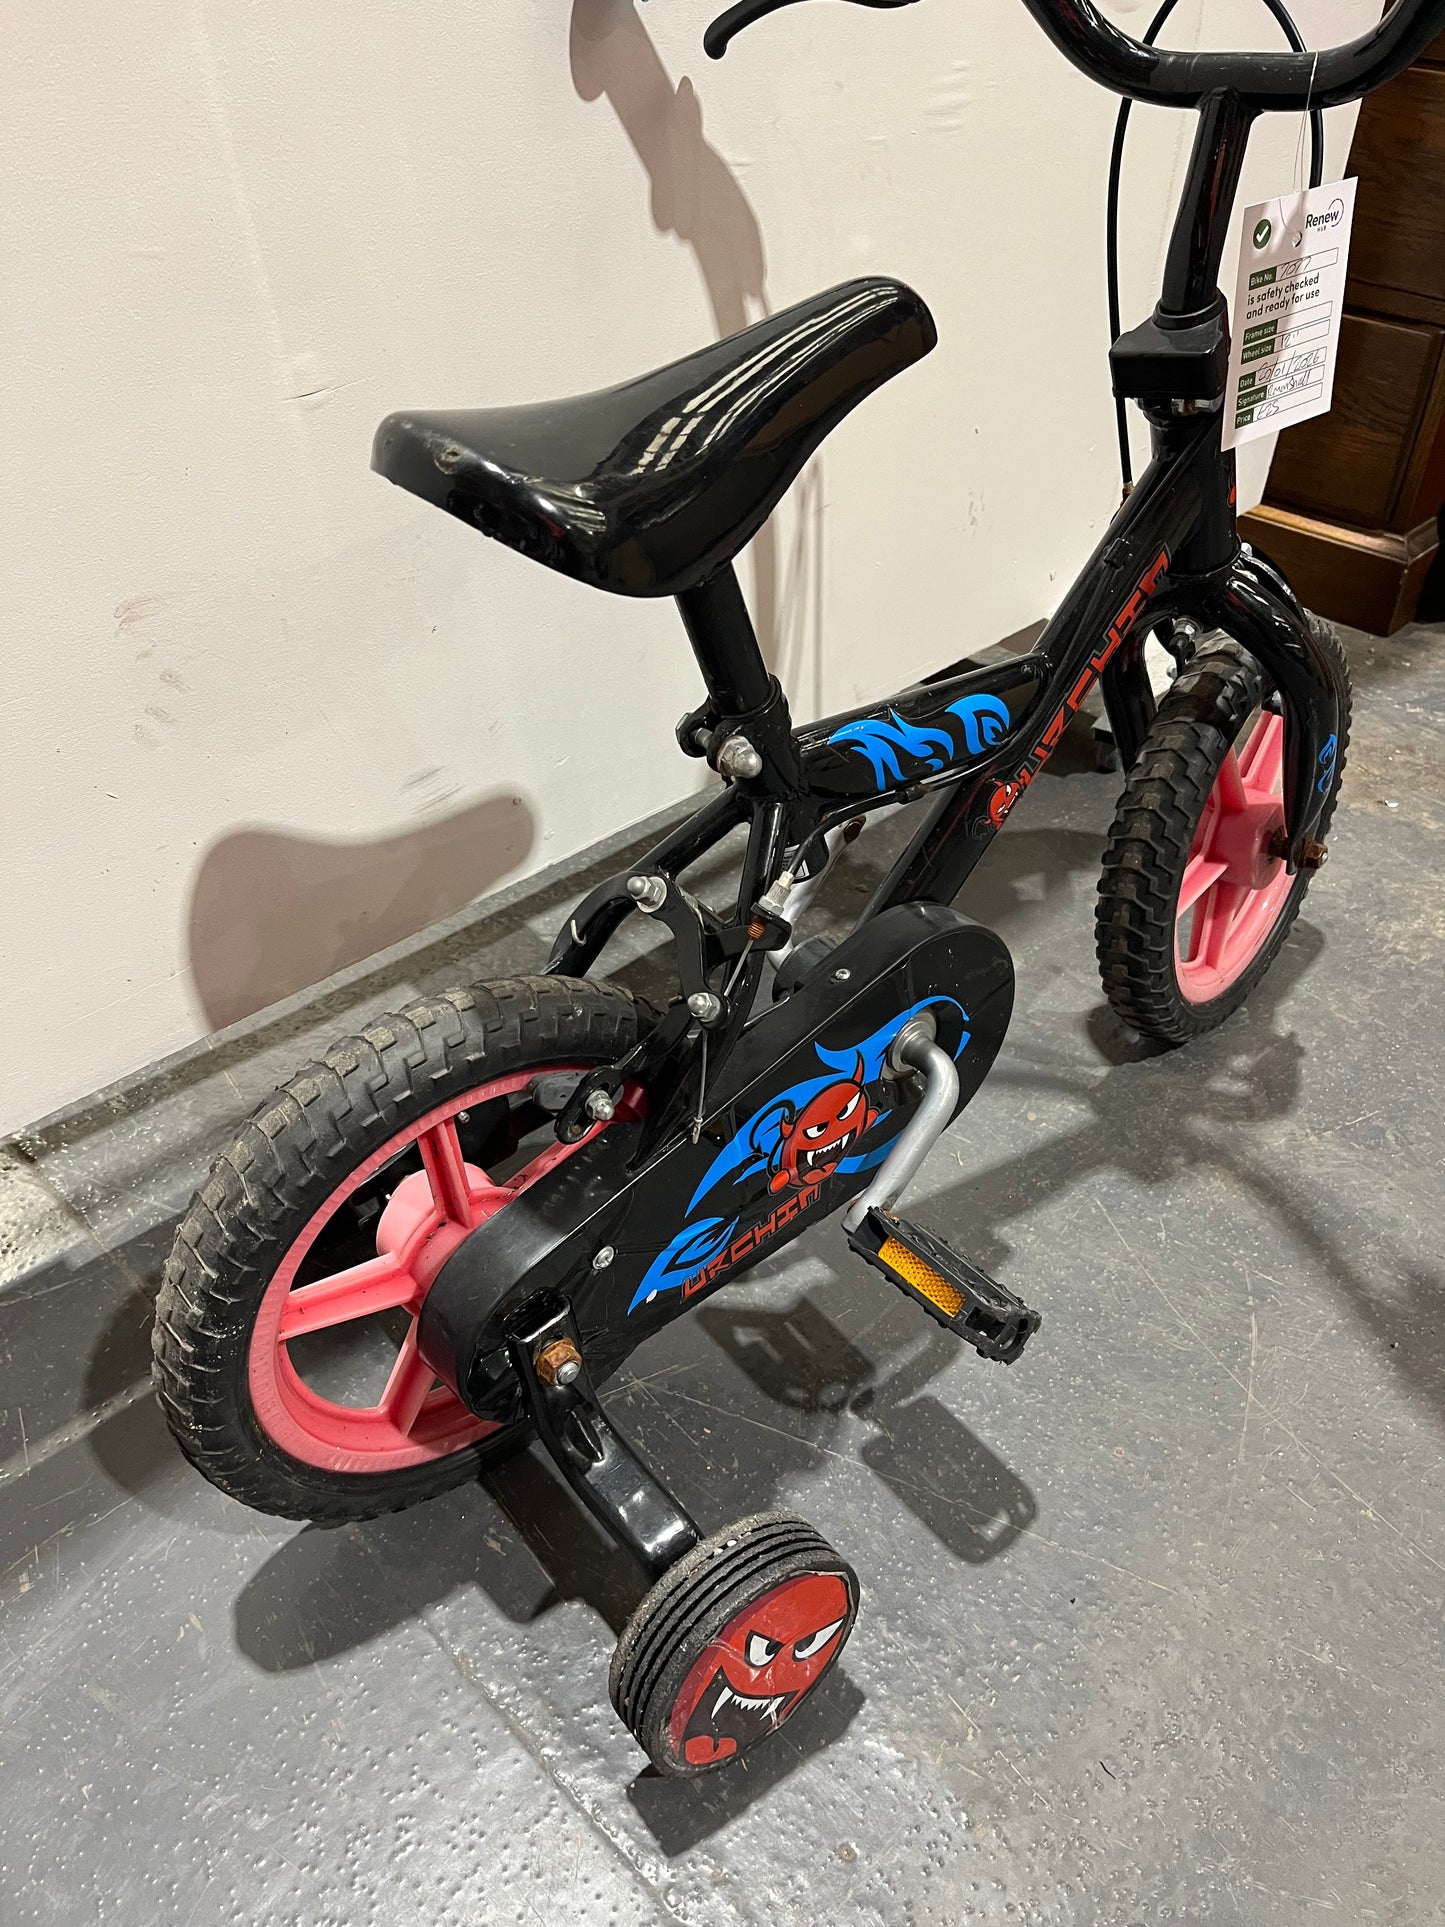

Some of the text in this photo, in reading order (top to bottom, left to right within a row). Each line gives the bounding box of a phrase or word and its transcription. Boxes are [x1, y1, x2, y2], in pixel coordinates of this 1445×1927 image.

[1305, 210, 1340, 229] Renew
[1247, 272, 1320, 306] is safety checked
[1250, 275, 1262, 286] Bike
[1246, 289, 1320, 320] and ready for use
[1245, 325, 1275, 341] Frame size
[1242, 344, 1272, 360] Wheel size
[1240, 377, 1253, 386] Date
[1238, 389, 1265, 407] Signature
[1236, 415, 1251, 424] Price
[681, 1184, 820, 1301] URCHIN
